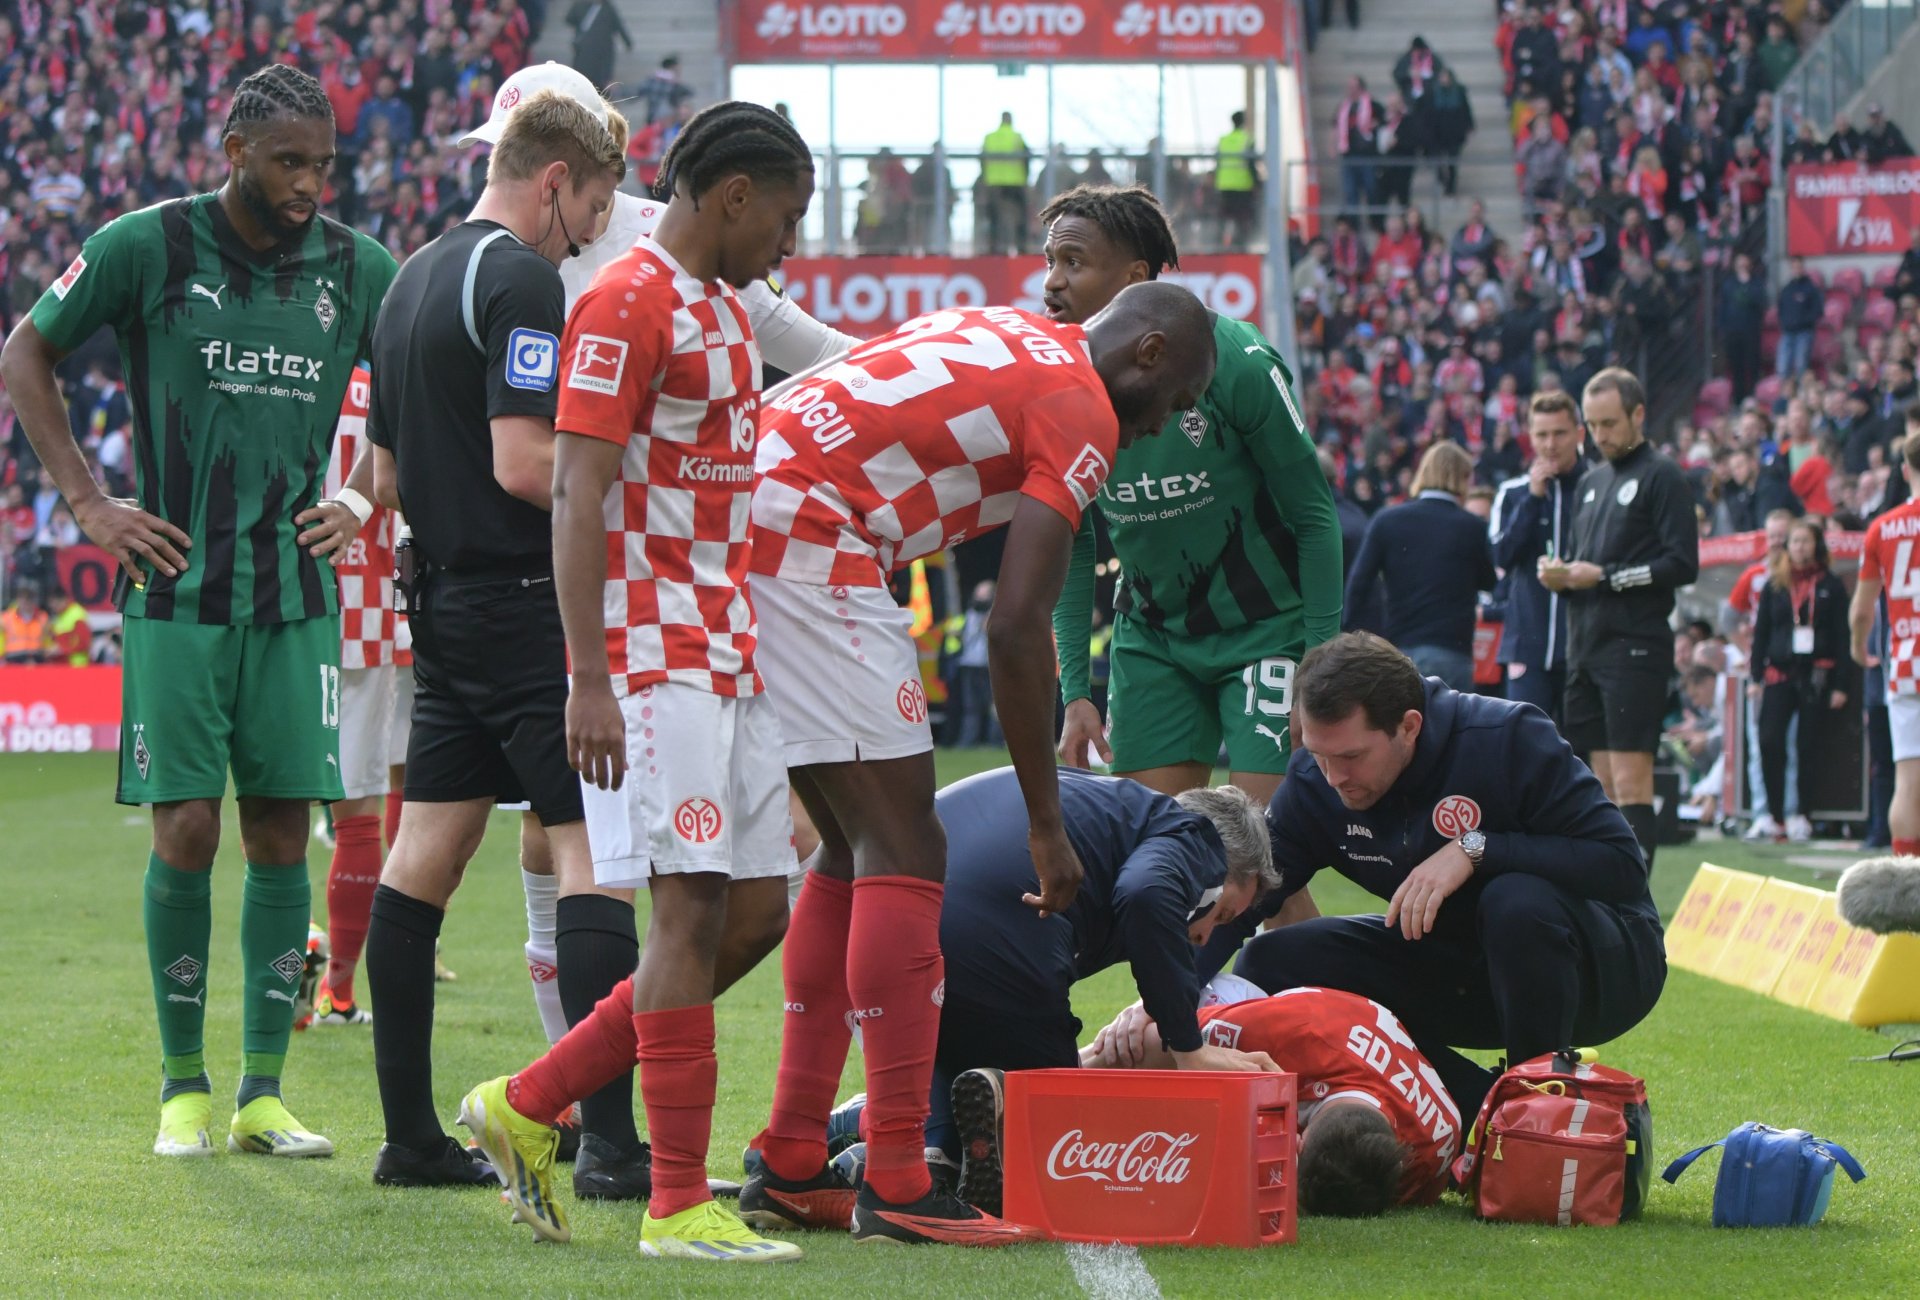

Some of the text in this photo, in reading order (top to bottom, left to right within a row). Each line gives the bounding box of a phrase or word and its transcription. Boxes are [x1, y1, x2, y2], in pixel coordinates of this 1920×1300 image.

[801, 5, 906, 37] LOTTO
[978, 5, 1085, 37] LOTTO
[1158, 5, 1264, 37] LOTTO
[1851, 217, 1894, 246] SVA
[813, 272, 987, 323] LOTTO
[705, 331, 723, 346] JAKO
[1021, 336, 1075, 365] 05
[208, 380, 317, 404] Anlegen bei den Profis
[512, 376, 524, 384] Das
[573, 377, 615, 391] BUNDESLIGA
[1098, 471, 1211, 503] latex
[1139, 511, 1157, 522] bei
[1160, 507, 1183, 520] den
[1184, 495, 1215, 513] Profis
[320, 664, 341, 730] 13
[1243, 656, 1296, 718] 19
[1347, 824, 1373, 839] JAKO
[1346, 1025, 1392, 1075] 05
[1390, 1059, 1455, 1178] MAINZ
[1047, 1129, 1199, 1184] Coca-Cola
[1104, 1185, 1143, 1193] Schutzmarke
